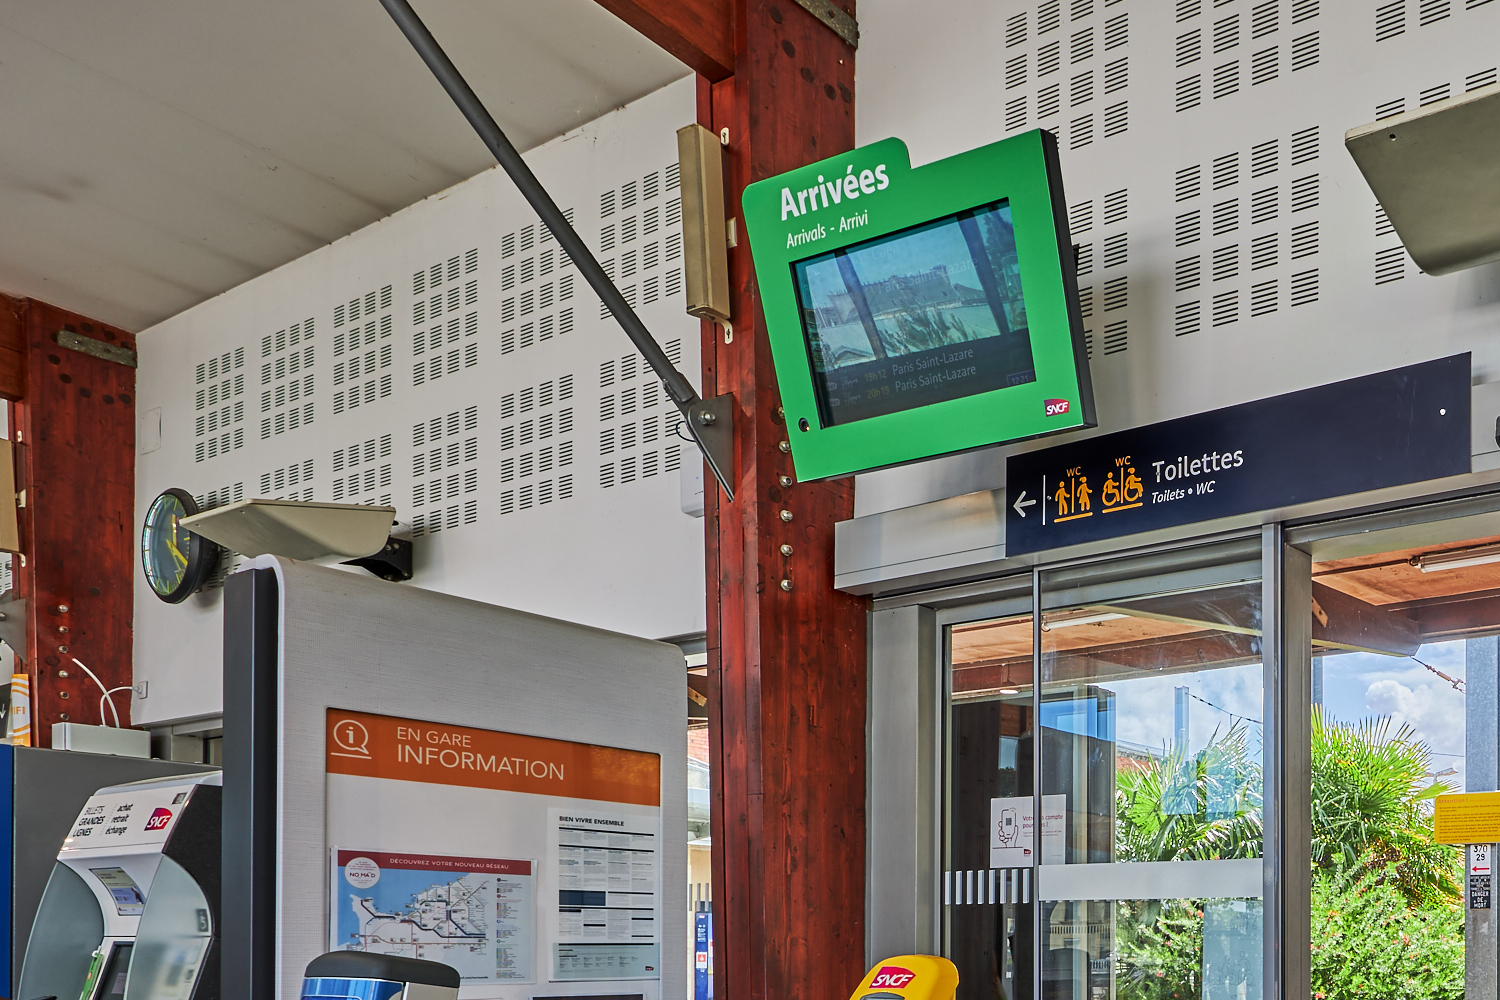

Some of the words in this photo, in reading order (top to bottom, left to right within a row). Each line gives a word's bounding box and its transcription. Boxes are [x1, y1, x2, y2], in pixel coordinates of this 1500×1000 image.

[781, 164, 889, 221] Arrivées
[787, 223, 826, 249] Arrivals
[839, 209, 868, 233] Arrivi
[893, 361, 915, 376] Paris
[916, 348, 974, 371] Saint-Lazare
[895, 379, 918, 393] Paris
[919, 365, 977, 388] Saint-Lazare
[1047, 402, 1069, 415] SNCF
[1115, 456, 1131, 467] WC
[1152, 450, 1244, 483] Toilettes
[1066, 466, 1082, 477] WC
[1151, 488, 1185, 504] Toilets
[1196, 480, 1216, 496] WC
[13, 706, 26, 715] IFI
[397, 726, 420, 742] EN
[426, 730, 472, 748] GARE
[397, 743, 565, 781] INFORMATION
[84, 805, 105, 816] BILLETS
[117, 803, 133, 812] achat
[79, 816, 106, 826] GRANDES
[147, 815, 171, 828] SNCF
[594, 819, 624, 827] ENSEMBLE
[73, 827, 93, 837] LIGNES
[390, 857, 430, 866] DÉCOUVREZ
[872, 974, 913, 987] SNCF
